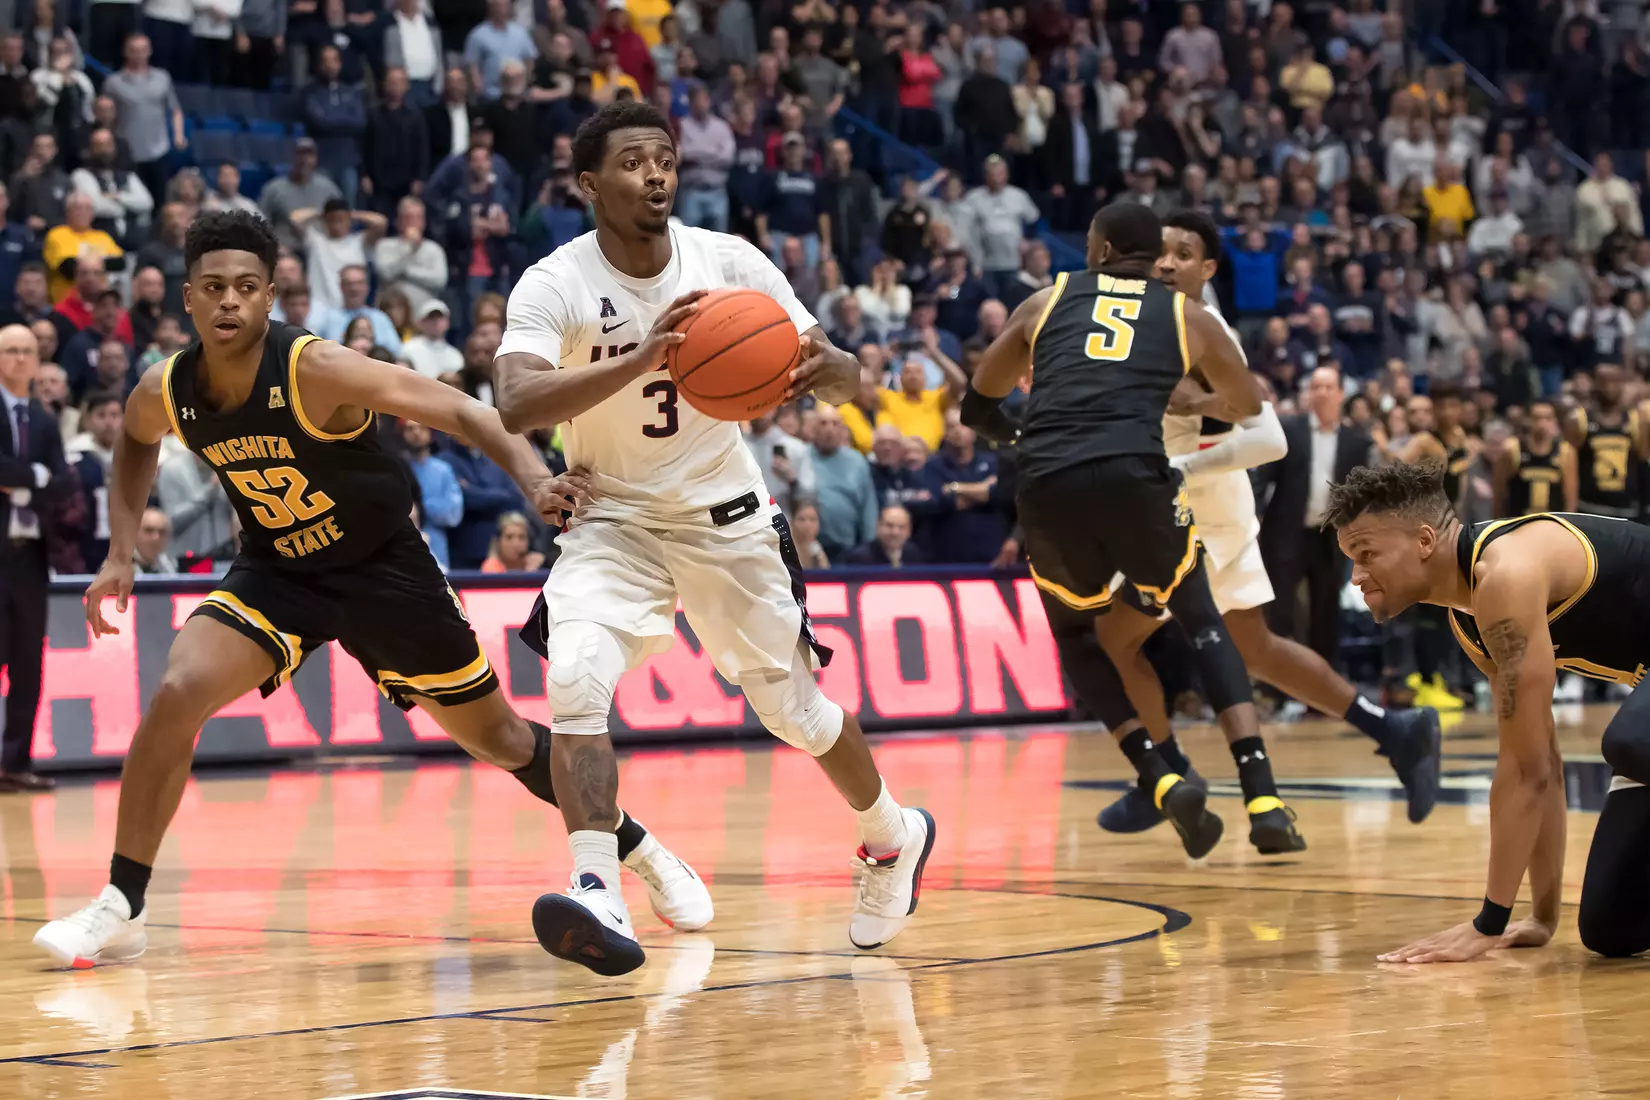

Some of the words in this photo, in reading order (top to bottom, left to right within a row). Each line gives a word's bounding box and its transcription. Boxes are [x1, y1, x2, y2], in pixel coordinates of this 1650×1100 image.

[1084, 295, 1142, 362] 5
[268, 386, 286, 409] A
[642, 379, 680, 439] 3
[201, 435, 296, 467] WICHITA
[225, 466, 336, 529] 52
[273, 515, 344, 559] STATE
[615, 592, 746, 731] &
[802, 577, 1067, 718] SON
